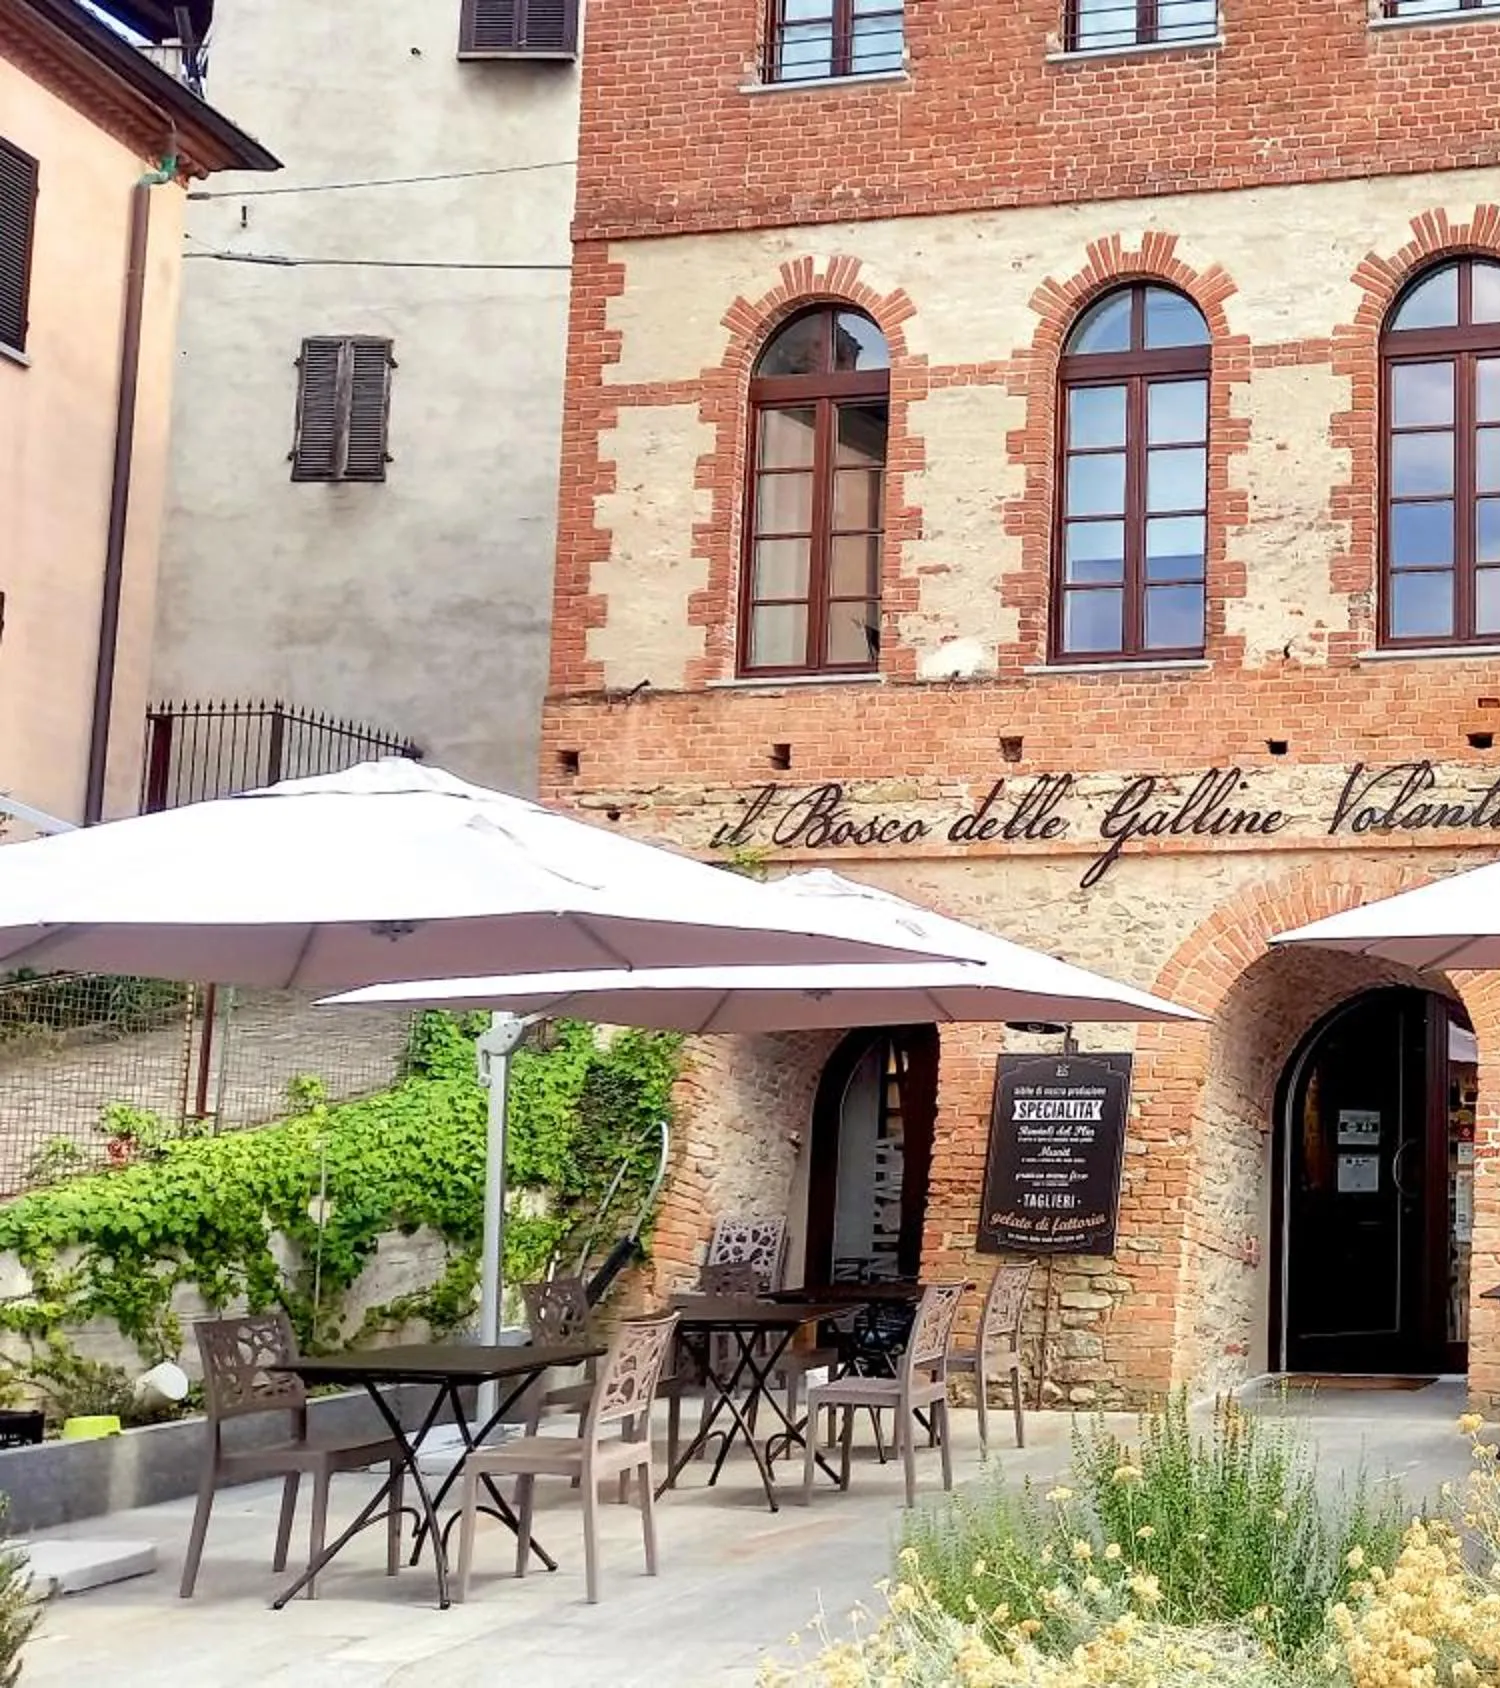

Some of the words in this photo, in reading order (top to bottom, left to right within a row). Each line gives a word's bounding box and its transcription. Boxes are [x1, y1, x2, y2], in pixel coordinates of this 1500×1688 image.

[709, 782, 777, 849] il
[771, 782, 932, 850] Bosco
[947, 772, 1073, 842] delle
[1080, 766, 1287, 890] Galline
[1023, 1193, 1075, 1209] TAGLIERI
[989, 1211, 1032, 1230] gelato
[1034, 1214, 1050, 1231] di
[1050, 1212, 1106, 1237] fattoria
